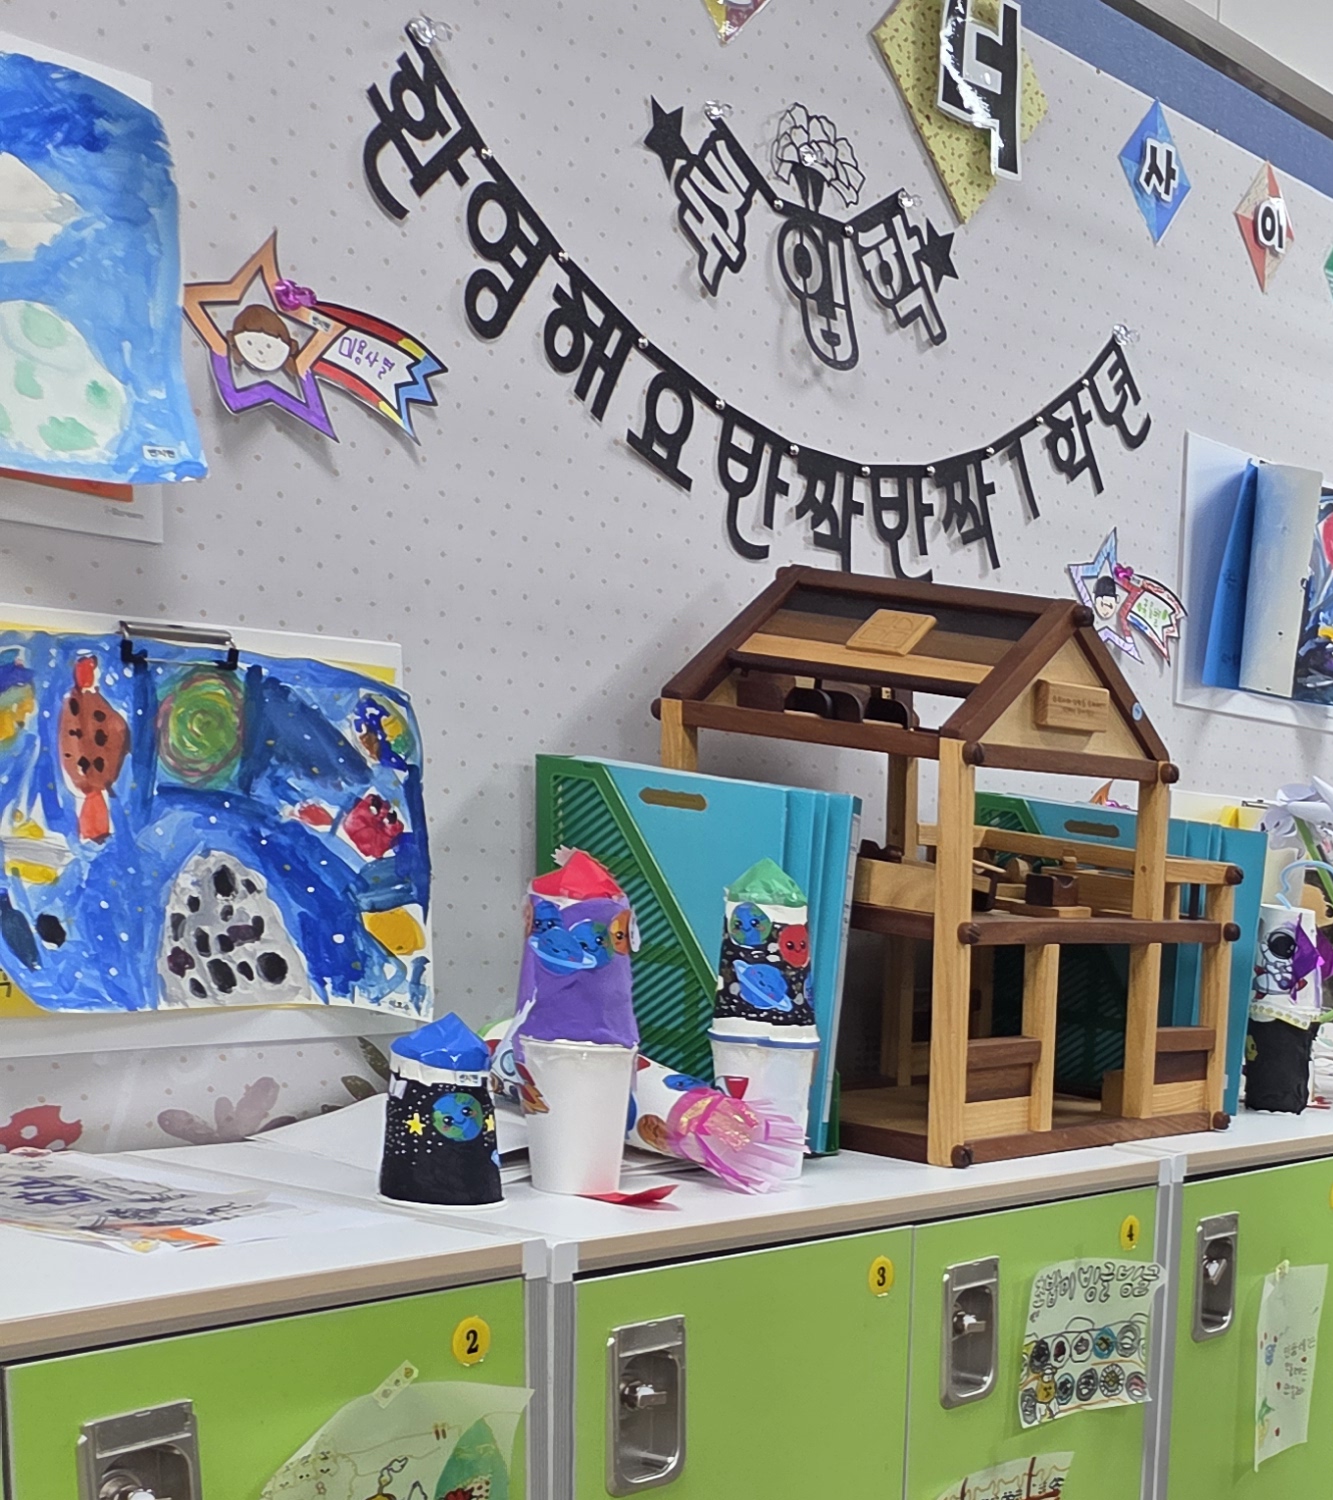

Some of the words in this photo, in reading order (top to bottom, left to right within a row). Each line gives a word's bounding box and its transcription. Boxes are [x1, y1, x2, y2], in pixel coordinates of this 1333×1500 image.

[1126, 1223, 1135, 1242] 4
[876, 1265, 887, 1287] 3
[465, 1328, 479, 1355] 2
